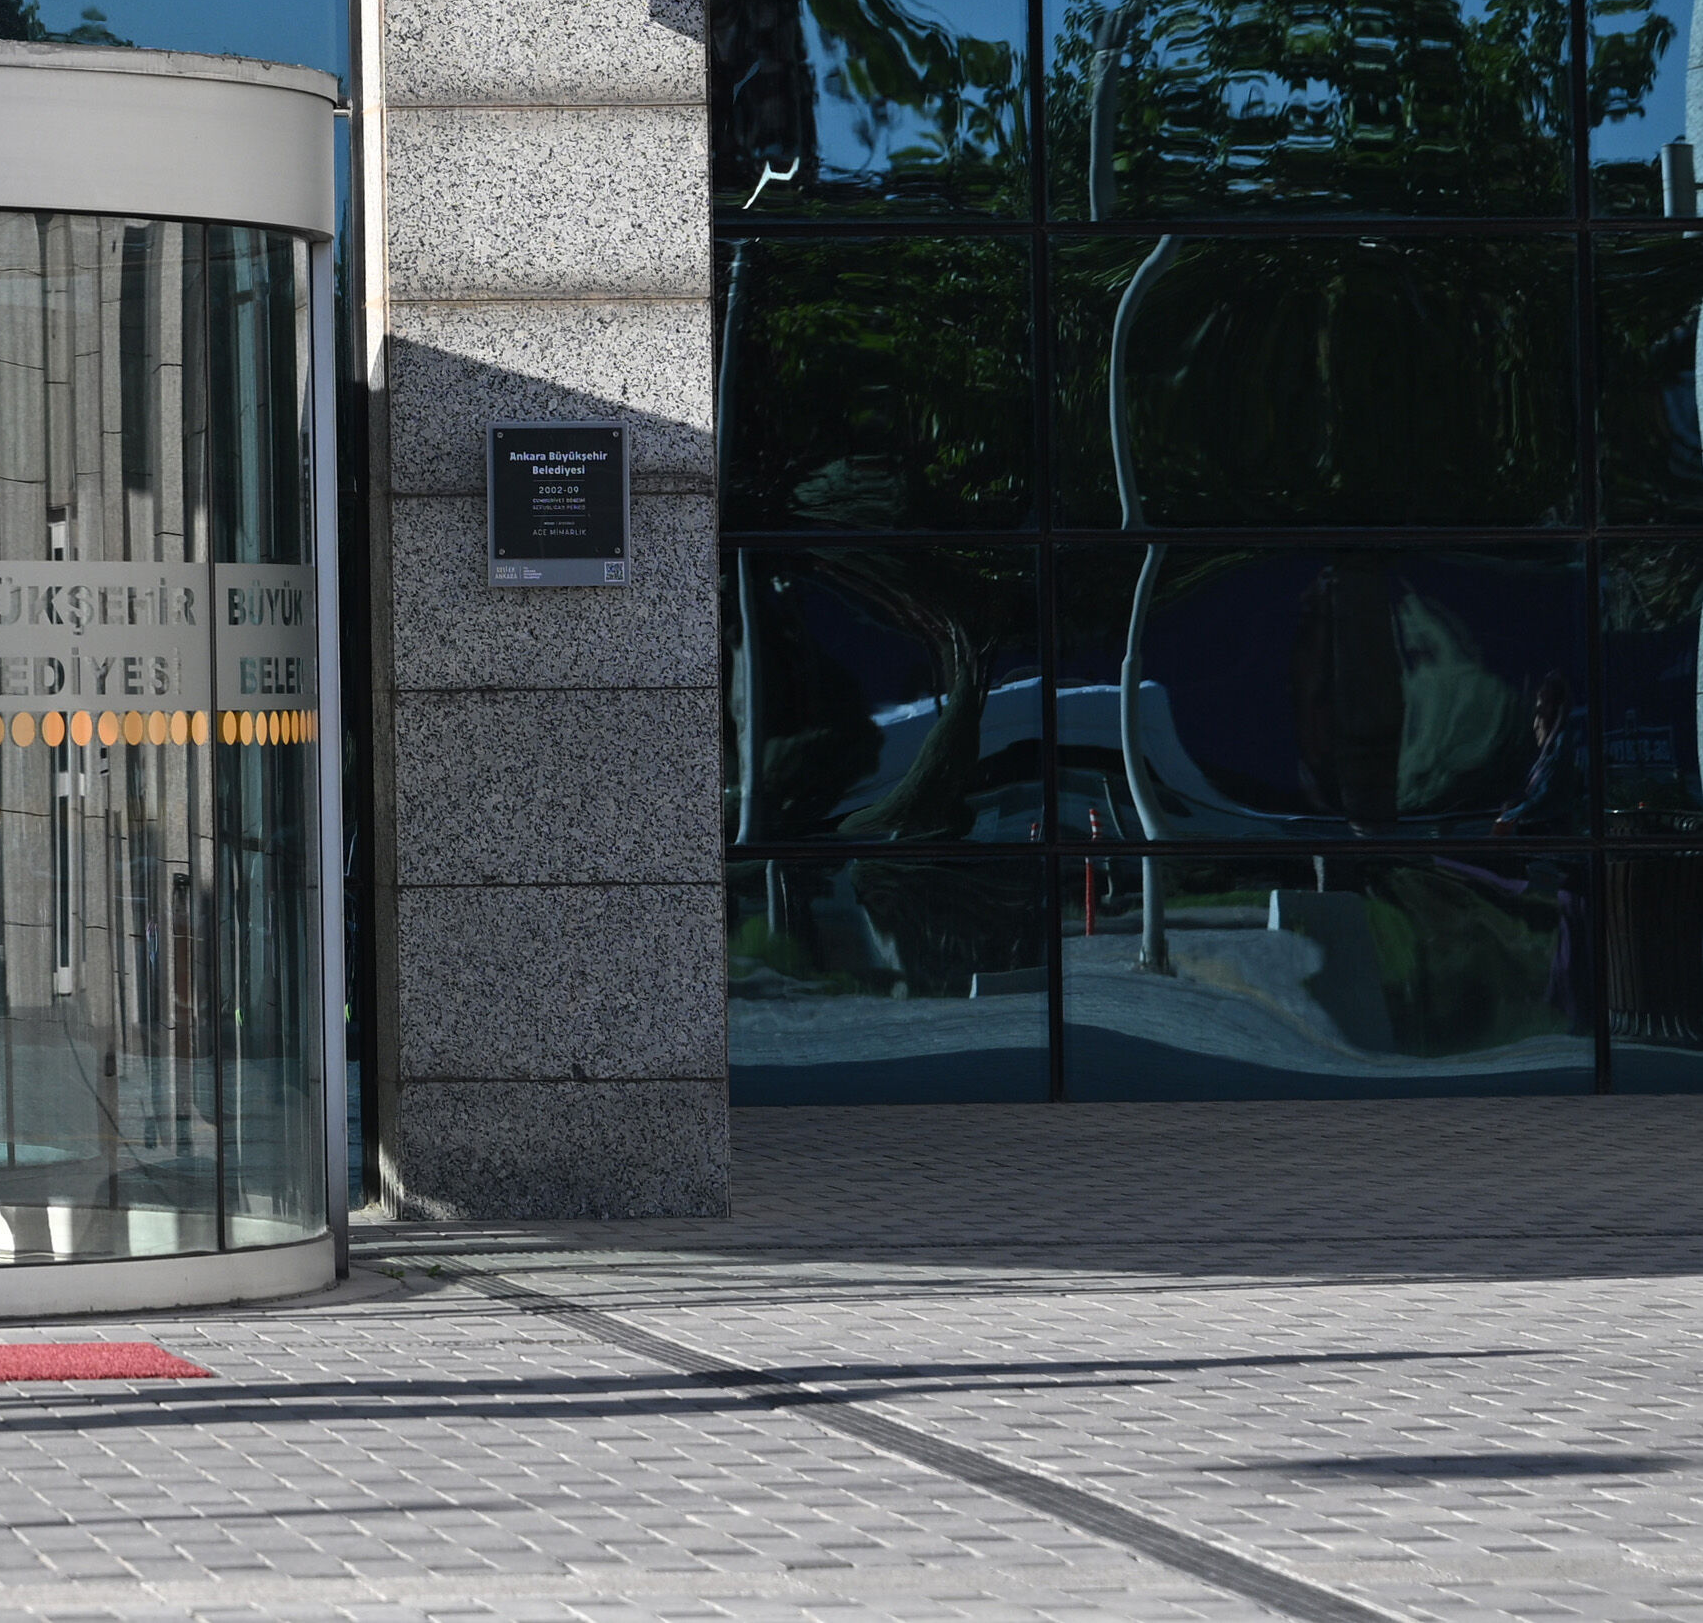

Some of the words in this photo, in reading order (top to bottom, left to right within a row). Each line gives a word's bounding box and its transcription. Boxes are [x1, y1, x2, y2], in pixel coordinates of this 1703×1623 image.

[509, 451, 546, 461] Ankara
[549, 451, 608, 463] Büyükşehir
[532, 465, 585, 476] Belediyesi
[538, 486, 579, 494] 2002-09
